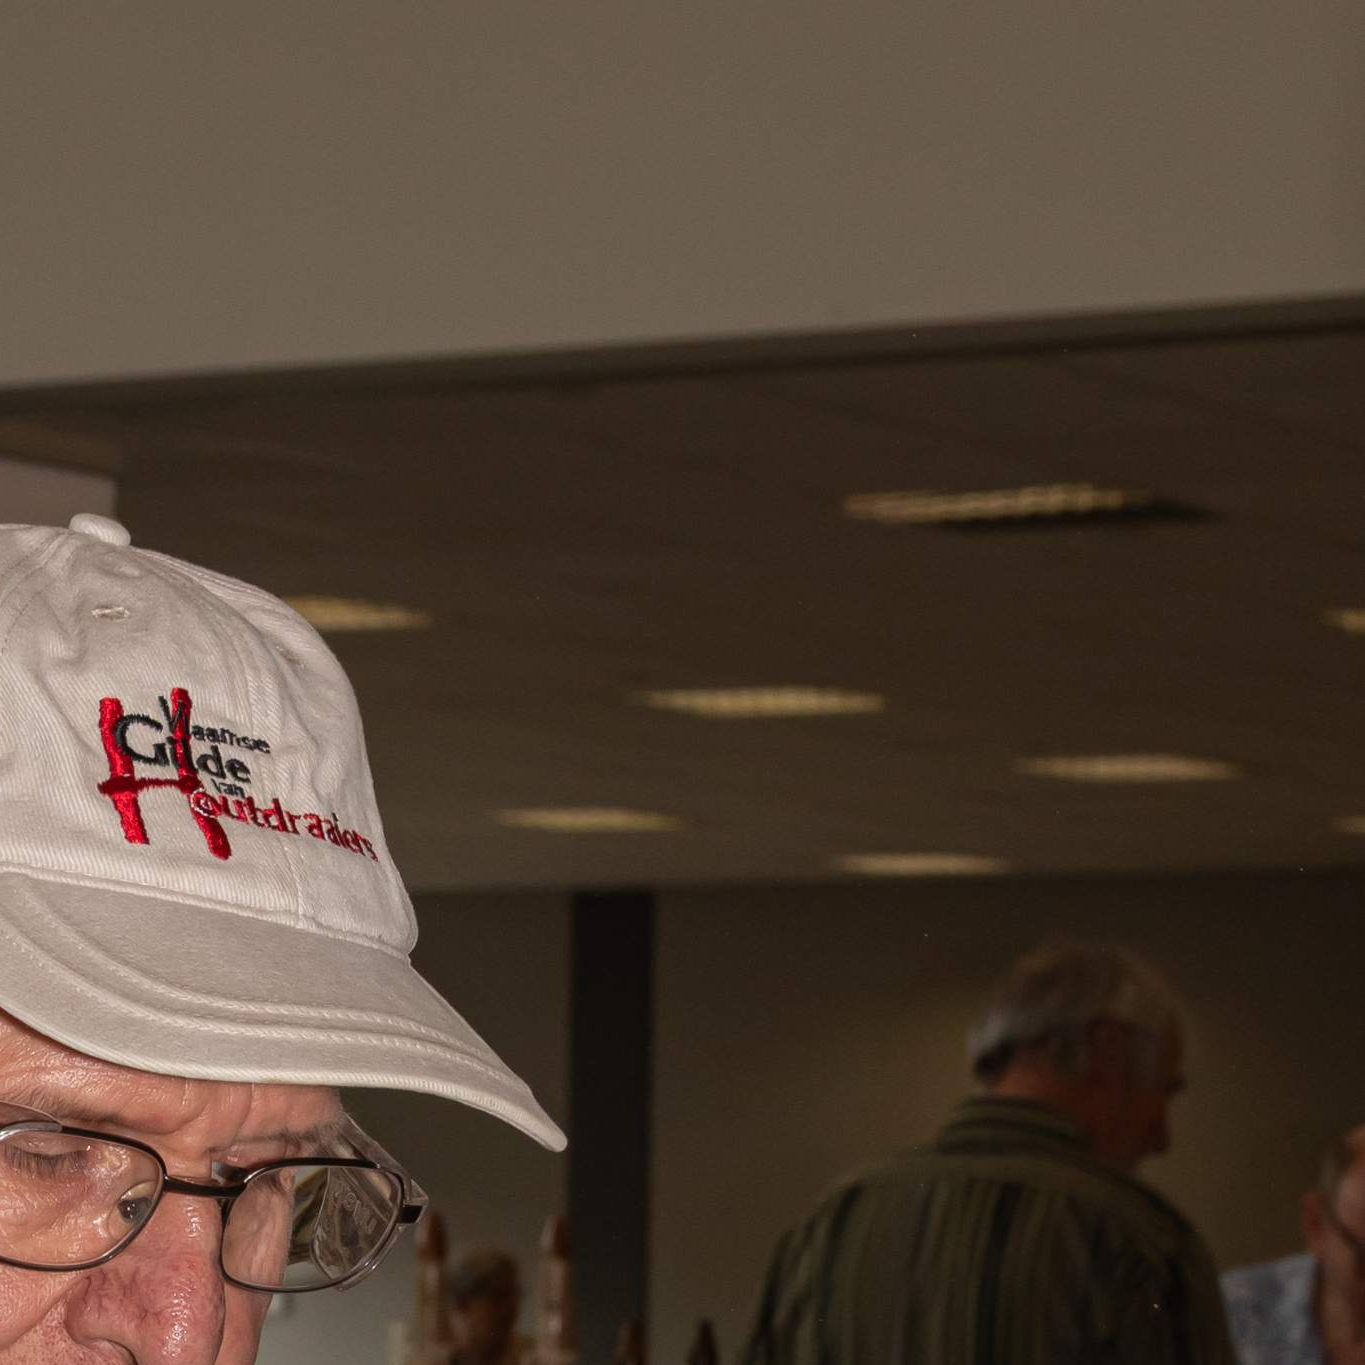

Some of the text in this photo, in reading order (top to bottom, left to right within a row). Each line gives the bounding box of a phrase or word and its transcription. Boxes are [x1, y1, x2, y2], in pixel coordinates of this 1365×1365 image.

[115, 713, 251, 784] Gilde
[157, 695, 272, 754] Vlaamse
[212, 778, 246, 798] van
